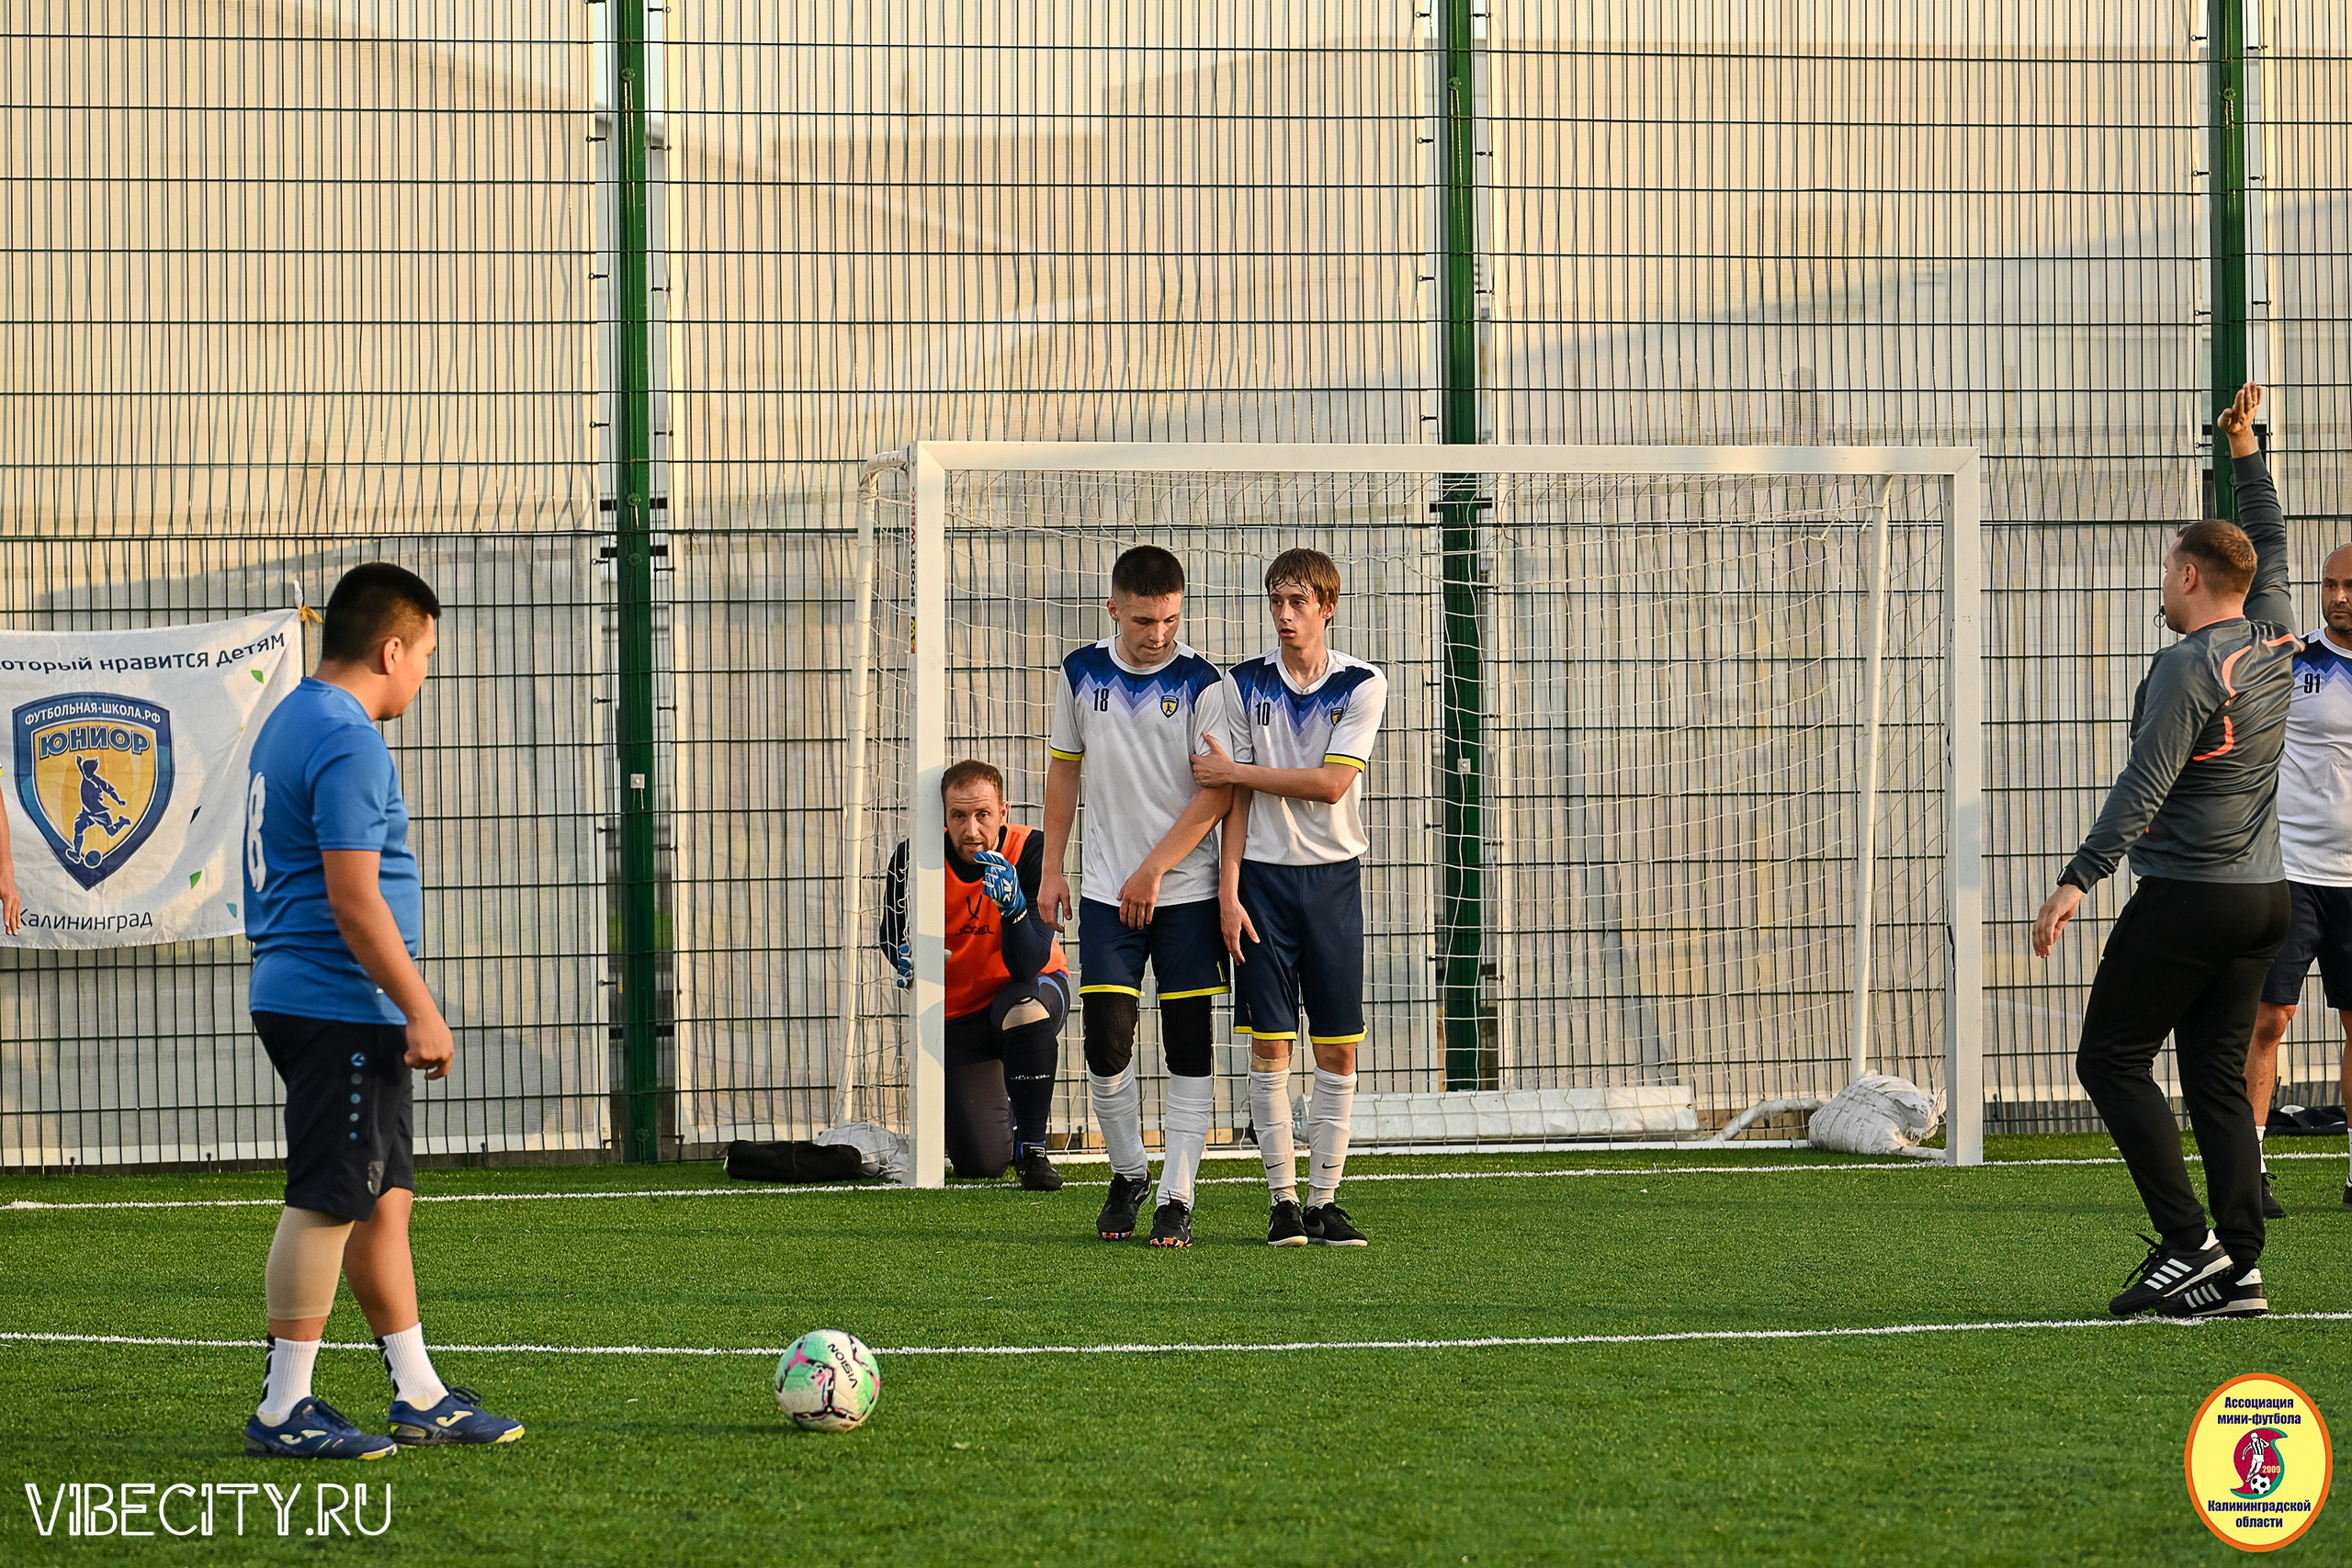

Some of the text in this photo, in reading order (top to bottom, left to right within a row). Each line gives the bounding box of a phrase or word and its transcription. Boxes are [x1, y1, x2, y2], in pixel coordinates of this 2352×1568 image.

[0, 632, 285, 674] оторый нравится детям
[2303, 672, 2321, 694] 91
[1093, 687, 1110, 712] 18
[1255, 702, 1271, 726] 10
[39, 726, 151, 760] ЮНИОР
[827, 1343, 858, 1389] VISION
